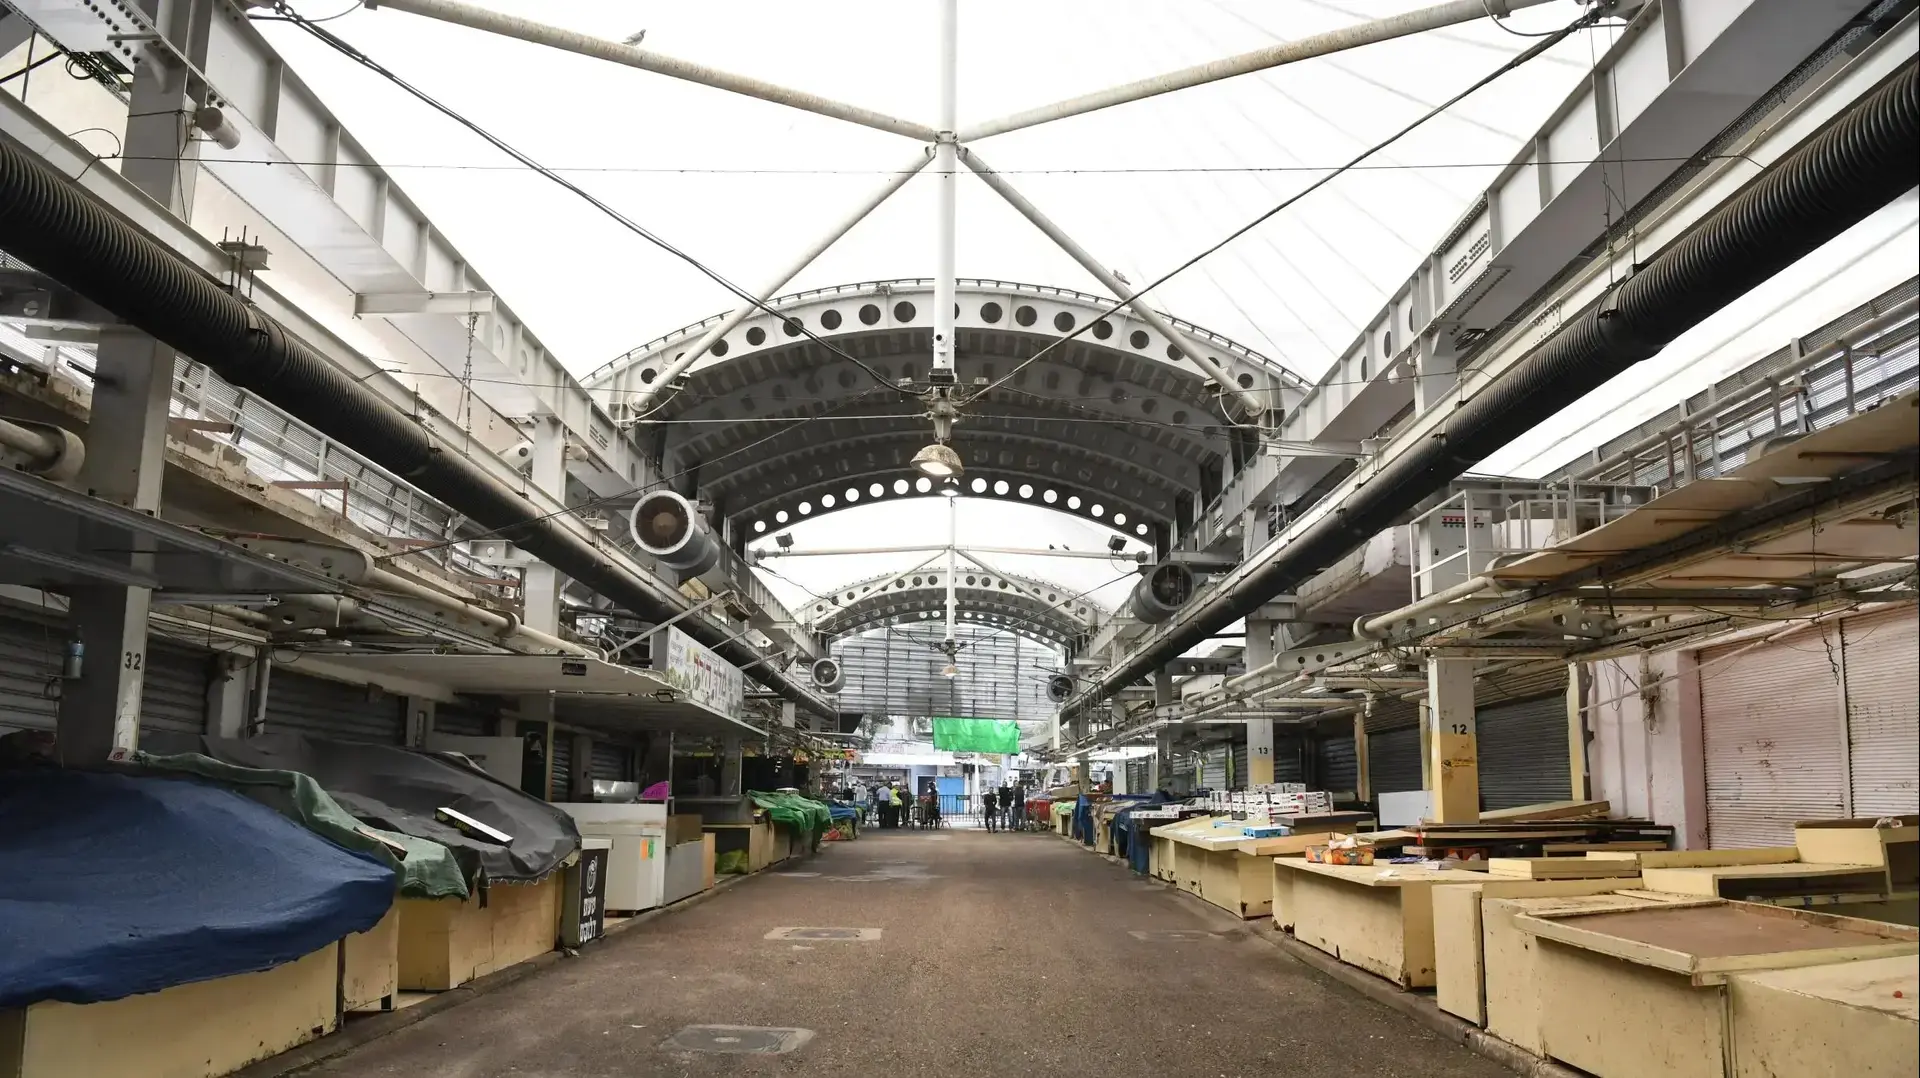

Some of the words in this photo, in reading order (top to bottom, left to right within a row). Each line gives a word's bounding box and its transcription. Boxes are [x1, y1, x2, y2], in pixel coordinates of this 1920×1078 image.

[125, 651, 141, 670] 32
[1452, 724, 1467, 735] 12
[1258, 746, 1268, 755] 13
